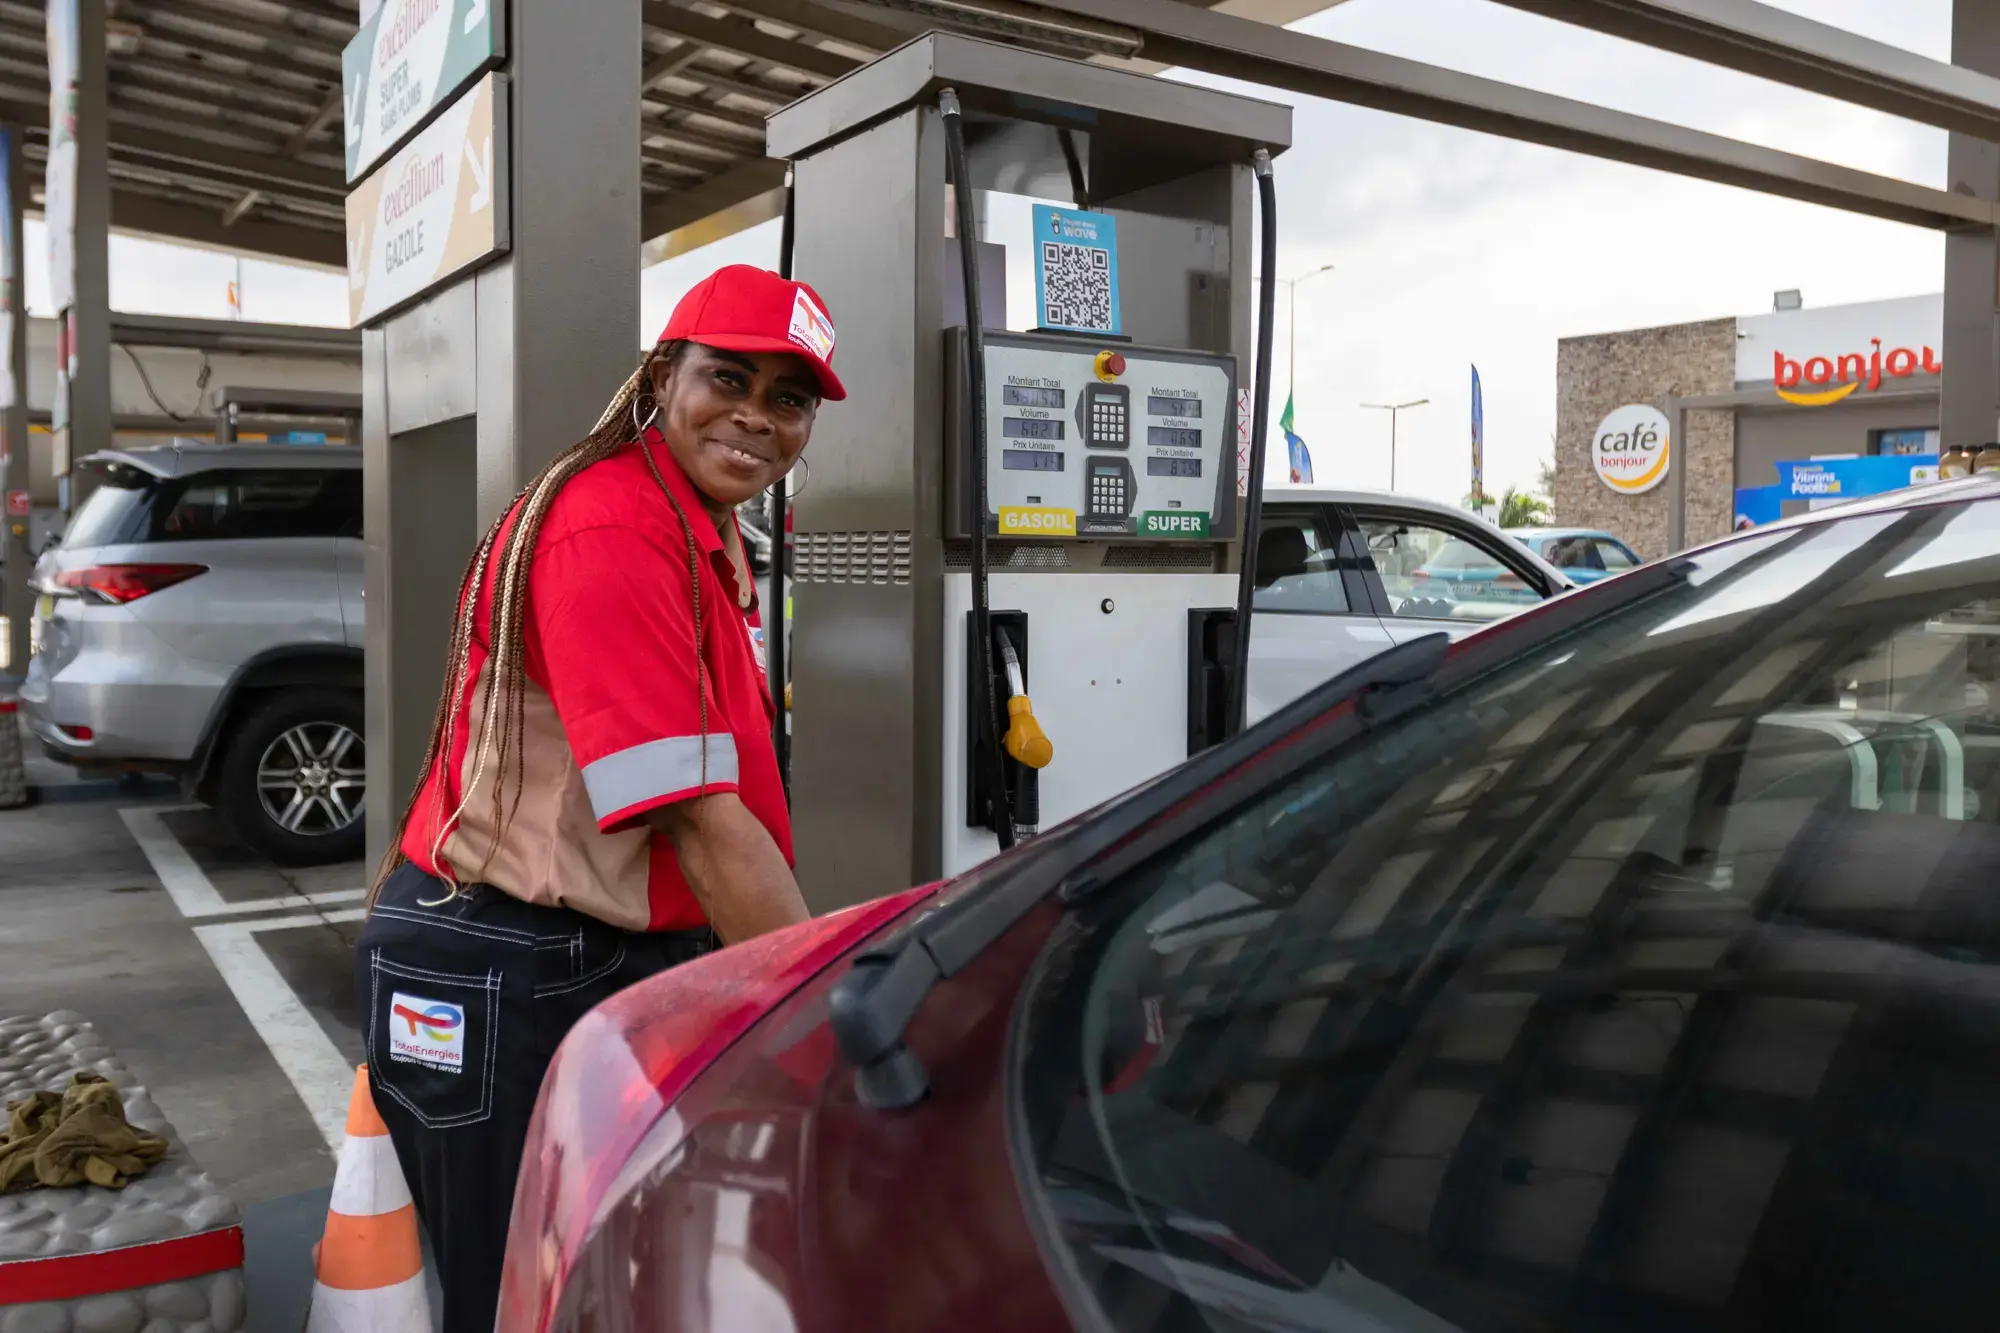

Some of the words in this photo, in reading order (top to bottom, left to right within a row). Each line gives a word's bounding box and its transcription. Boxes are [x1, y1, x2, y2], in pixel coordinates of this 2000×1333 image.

[380, 58, 409, 109] SUPER
[384, 152, 444, 225] excellium
[1063, 226, 1097, 240] wave
[385, 218, 424, 274] GAZOLE
[1774, 337, 1943, 391] bonjou
[1007, 376, 1041, 387] Montant
[1042, 378, 1061, 388] Total
[1151, 387, 1181, 398] Montant
[1181, 389, 1198, 399] Total
[1020, 408, 1050, 418] Volume
[1162, 417, 1188, 427] Volume
[1599, 422, 1658, 452] café
[1013, 440, 1027, 449] Prix
[1028, 442, 1056, 451] Unitaire
[1156, 447, 1169, 456] Prix
[1170, 449, 1194, 458] Unitaire
[1600, 454, 1648, 472] bonjour
[1005, 512, 1073, 529] GASOIL
[1147, 516, 1201, 532] SUPER
[393, 1040, 460, 1060] TotalEnergies
[438, 1065, 462, 1075] service
